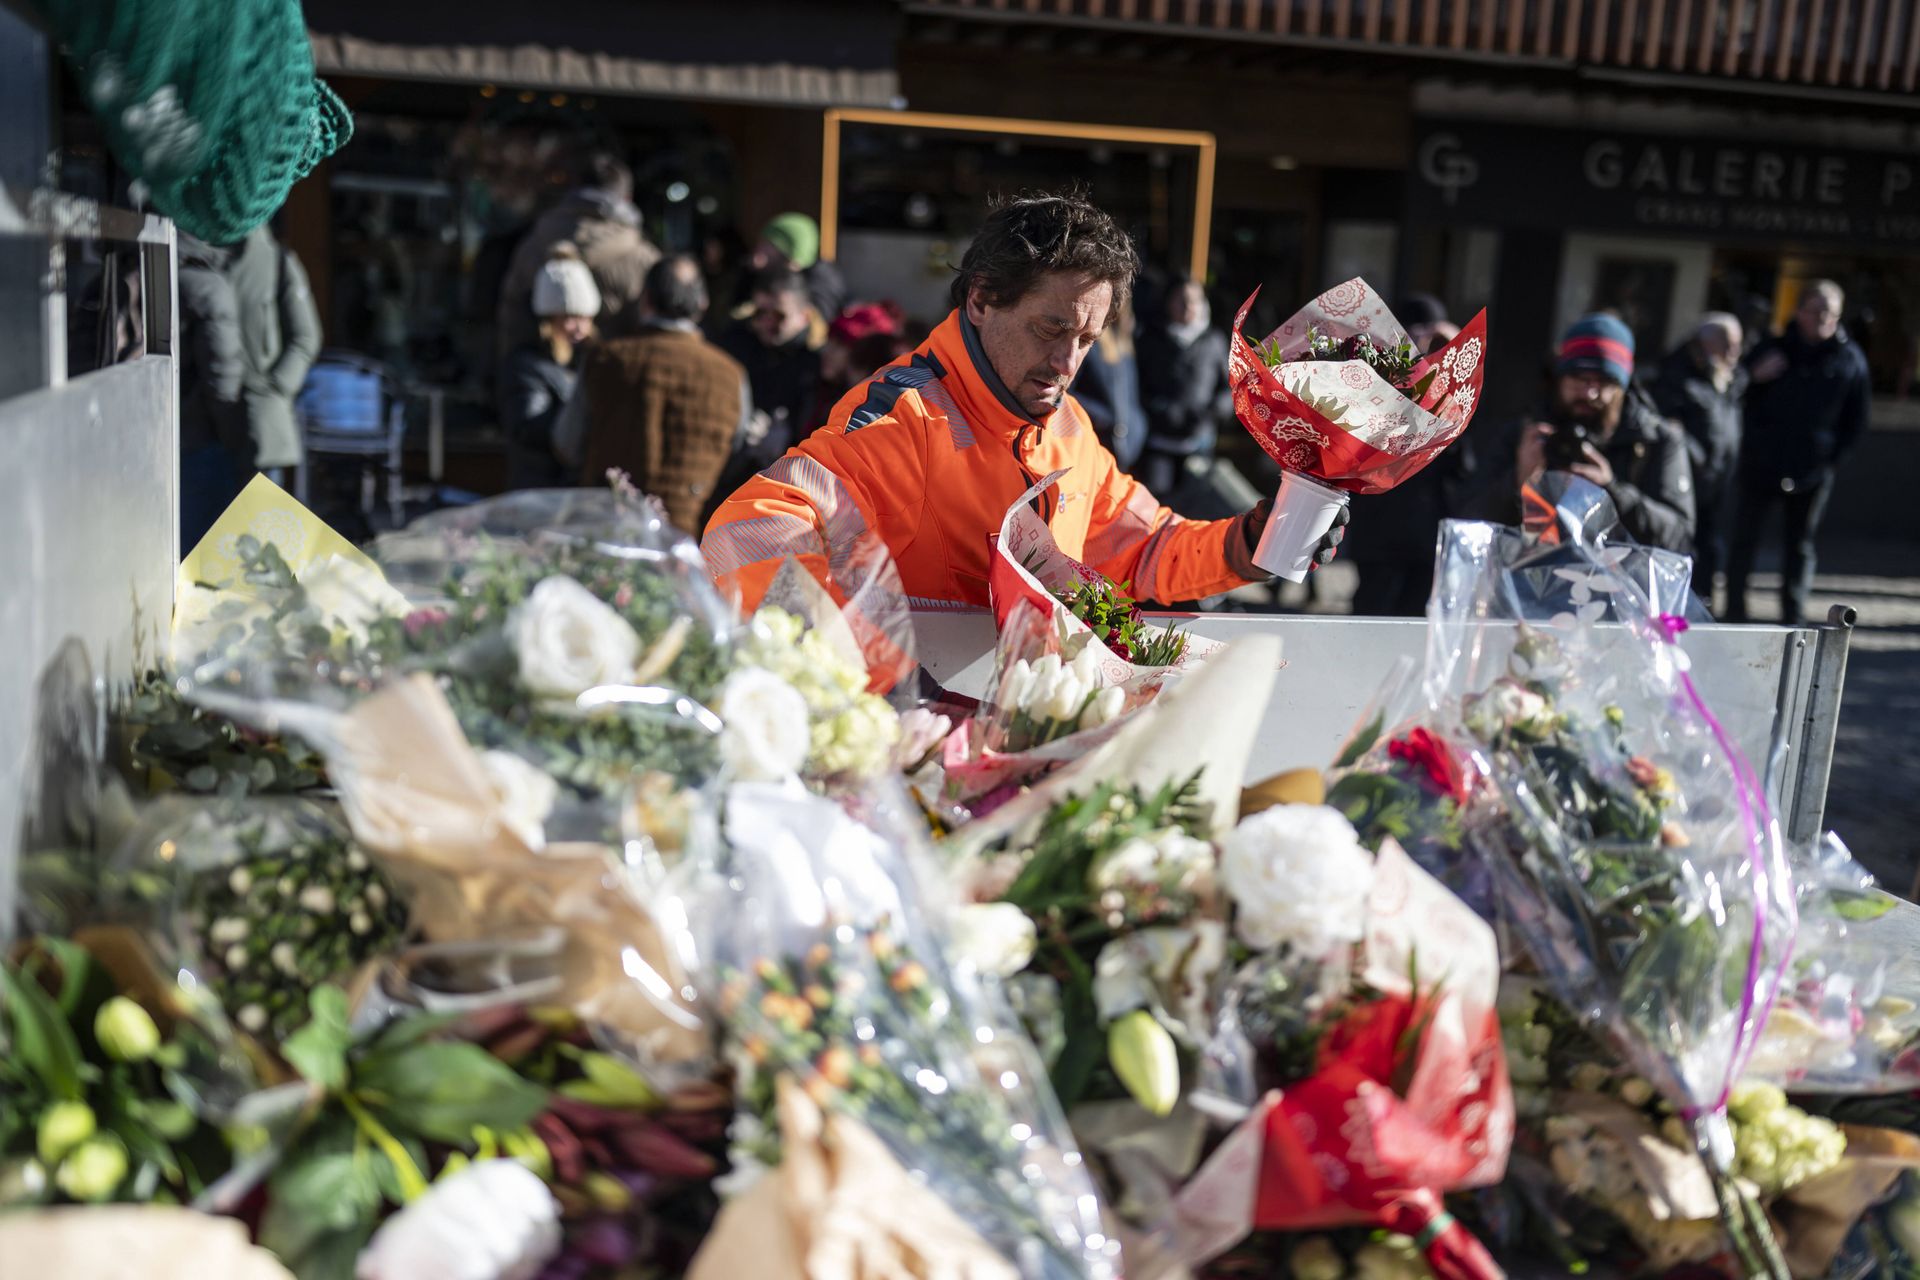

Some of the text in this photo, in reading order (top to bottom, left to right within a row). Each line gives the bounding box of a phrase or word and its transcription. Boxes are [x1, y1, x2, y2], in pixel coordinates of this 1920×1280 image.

[1582, 139, 1848, 204] GALERIE
[1635, 198, 1722, 227] CRANS
[1729, 207, 1850, 234] MONTANA
